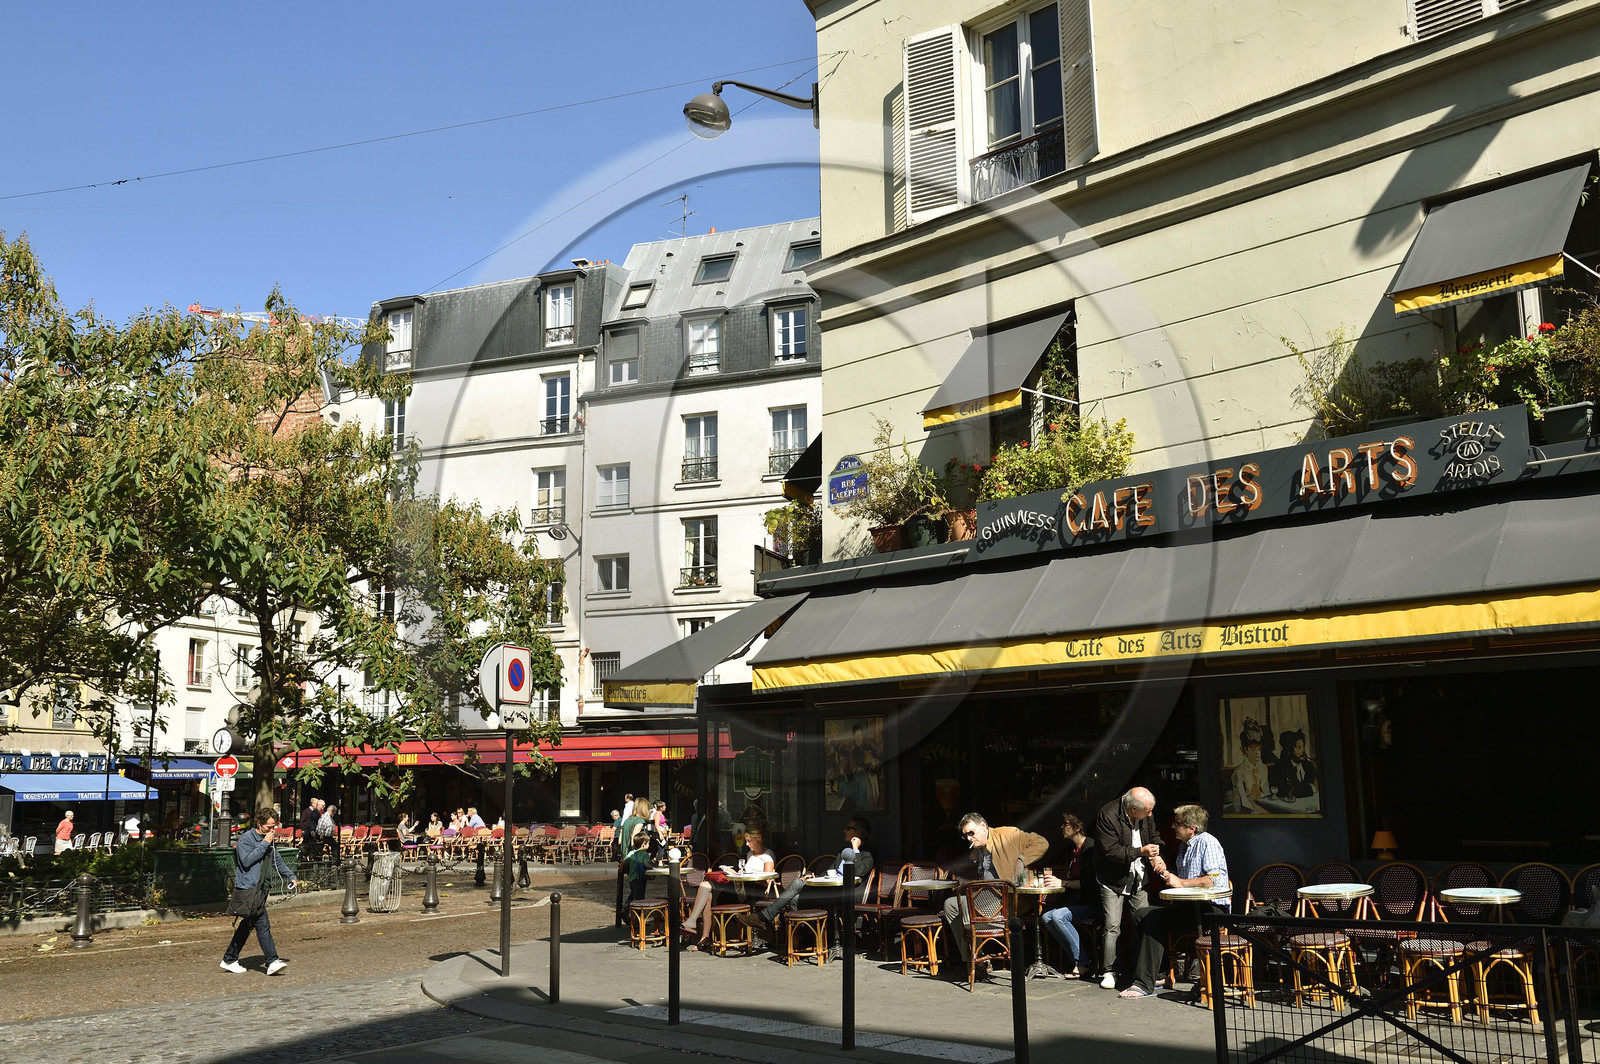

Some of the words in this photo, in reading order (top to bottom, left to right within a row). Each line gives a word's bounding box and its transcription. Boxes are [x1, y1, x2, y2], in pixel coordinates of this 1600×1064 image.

[1439, 271, 1514, 301] Brasserie
[960, 400, 984, 416] Café
[1440, 421, 1505, 445] STELLA
[1443, 454, 1501, 479] ARTOIS
[1065, 482, 1155, 536] CAFE
[1186, 463, 1263, 517] DES
[1300, 436, 1418, 499] ARTS
[981, 509, 1056, 540] GUINNESS
[1065, 636, 1104, 658] Café
[1117, 636, 1145, 655] des
[1160, 629, 1203, 652] Arts
[1219, 619, 1290, 650] Bistrot
[30, 757, 52, 771] DE
[397, 753, 418, 765] DELMAS
[661, 747, 685, 759] DELMAS
